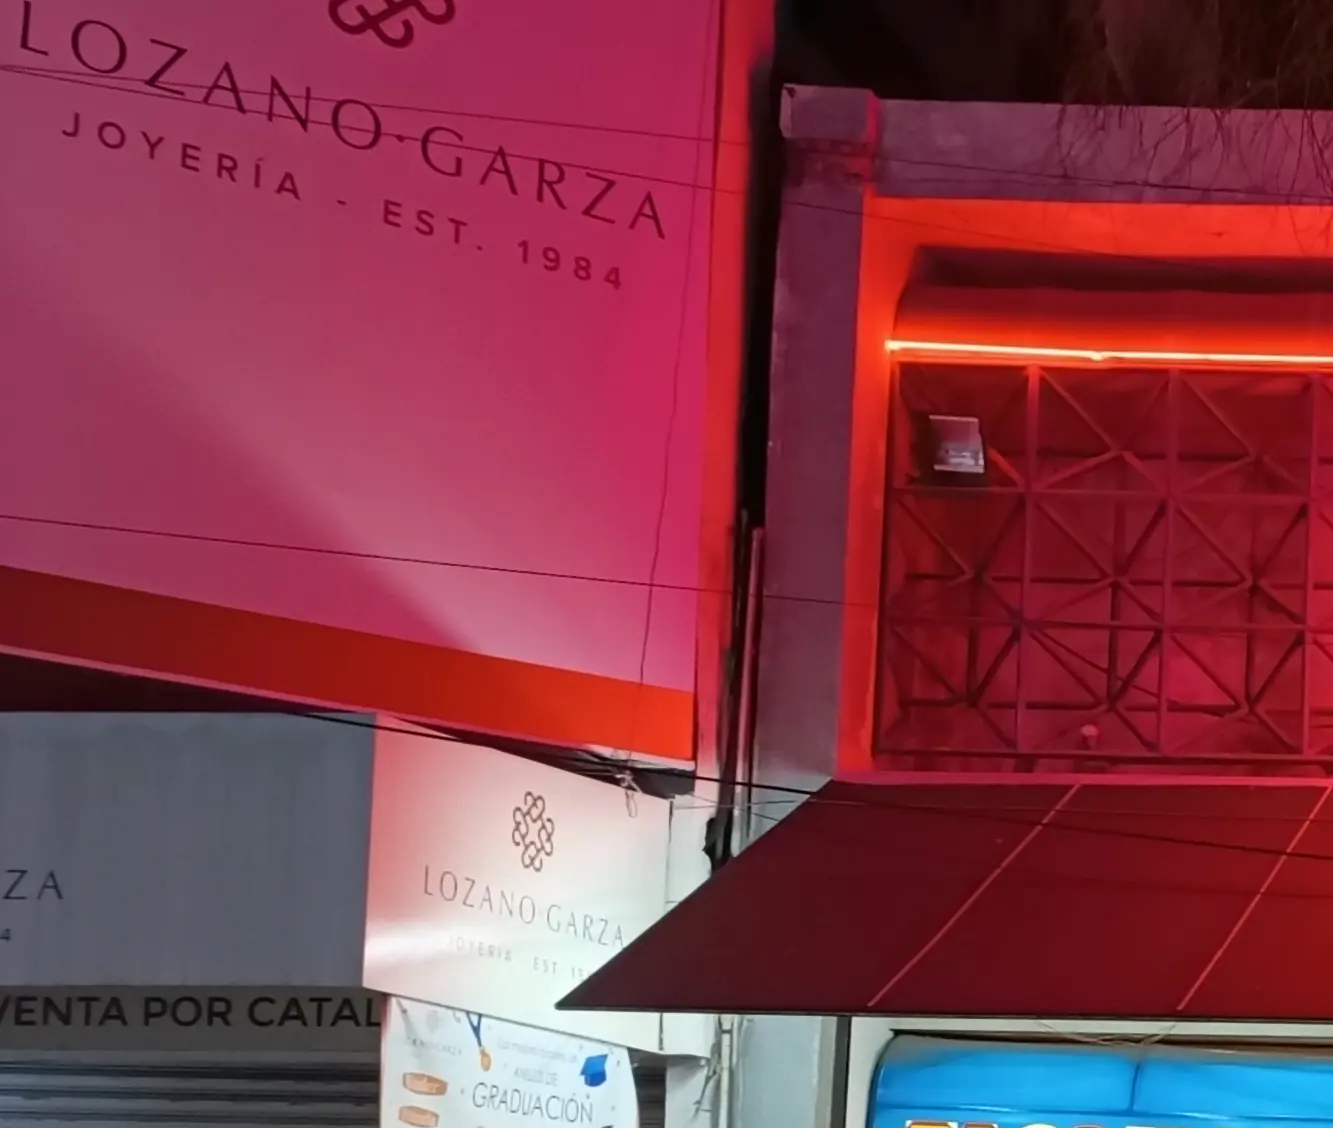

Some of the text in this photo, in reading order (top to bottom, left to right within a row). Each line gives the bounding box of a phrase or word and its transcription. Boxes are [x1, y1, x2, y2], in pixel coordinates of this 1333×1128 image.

[383, 200, 484, 251] EST.
[517, 240, 622, 291] 1984
[143, 995, 233, 1027] POR
[472, 1081, 594, 1124] GRADUACIÓN
